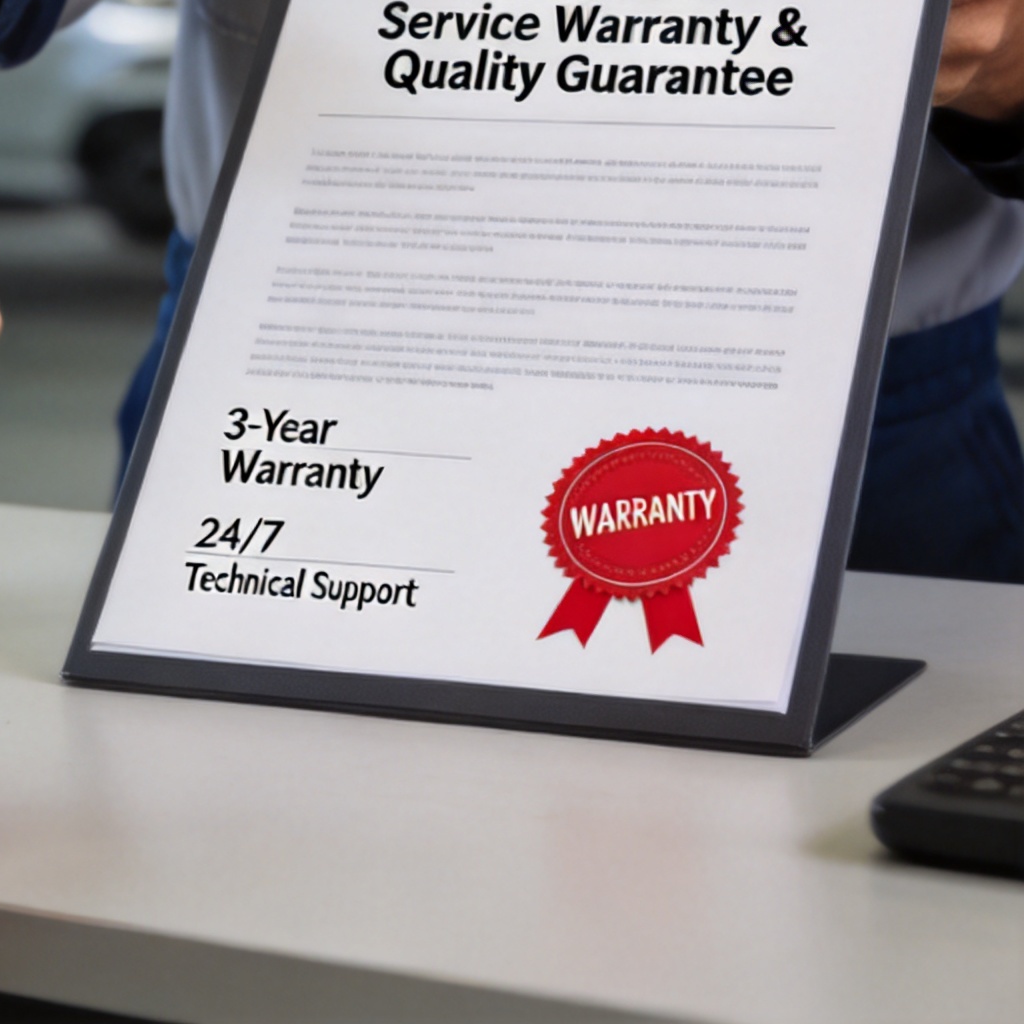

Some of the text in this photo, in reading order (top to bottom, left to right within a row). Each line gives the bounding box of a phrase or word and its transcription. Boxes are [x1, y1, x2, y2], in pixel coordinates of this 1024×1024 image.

[377, 0, 808, 55] Service Warranty &
[384, 48, 794, 103] Quality Guarantee
[223, 407, 338, 445] 3-Year
[221, 449, 385, 500] Warranty
[194, 517, 285, 554] 24/7
[569, 487, 717, 539] WARRANTY
[185, 561, 419, 611] Technical Support
